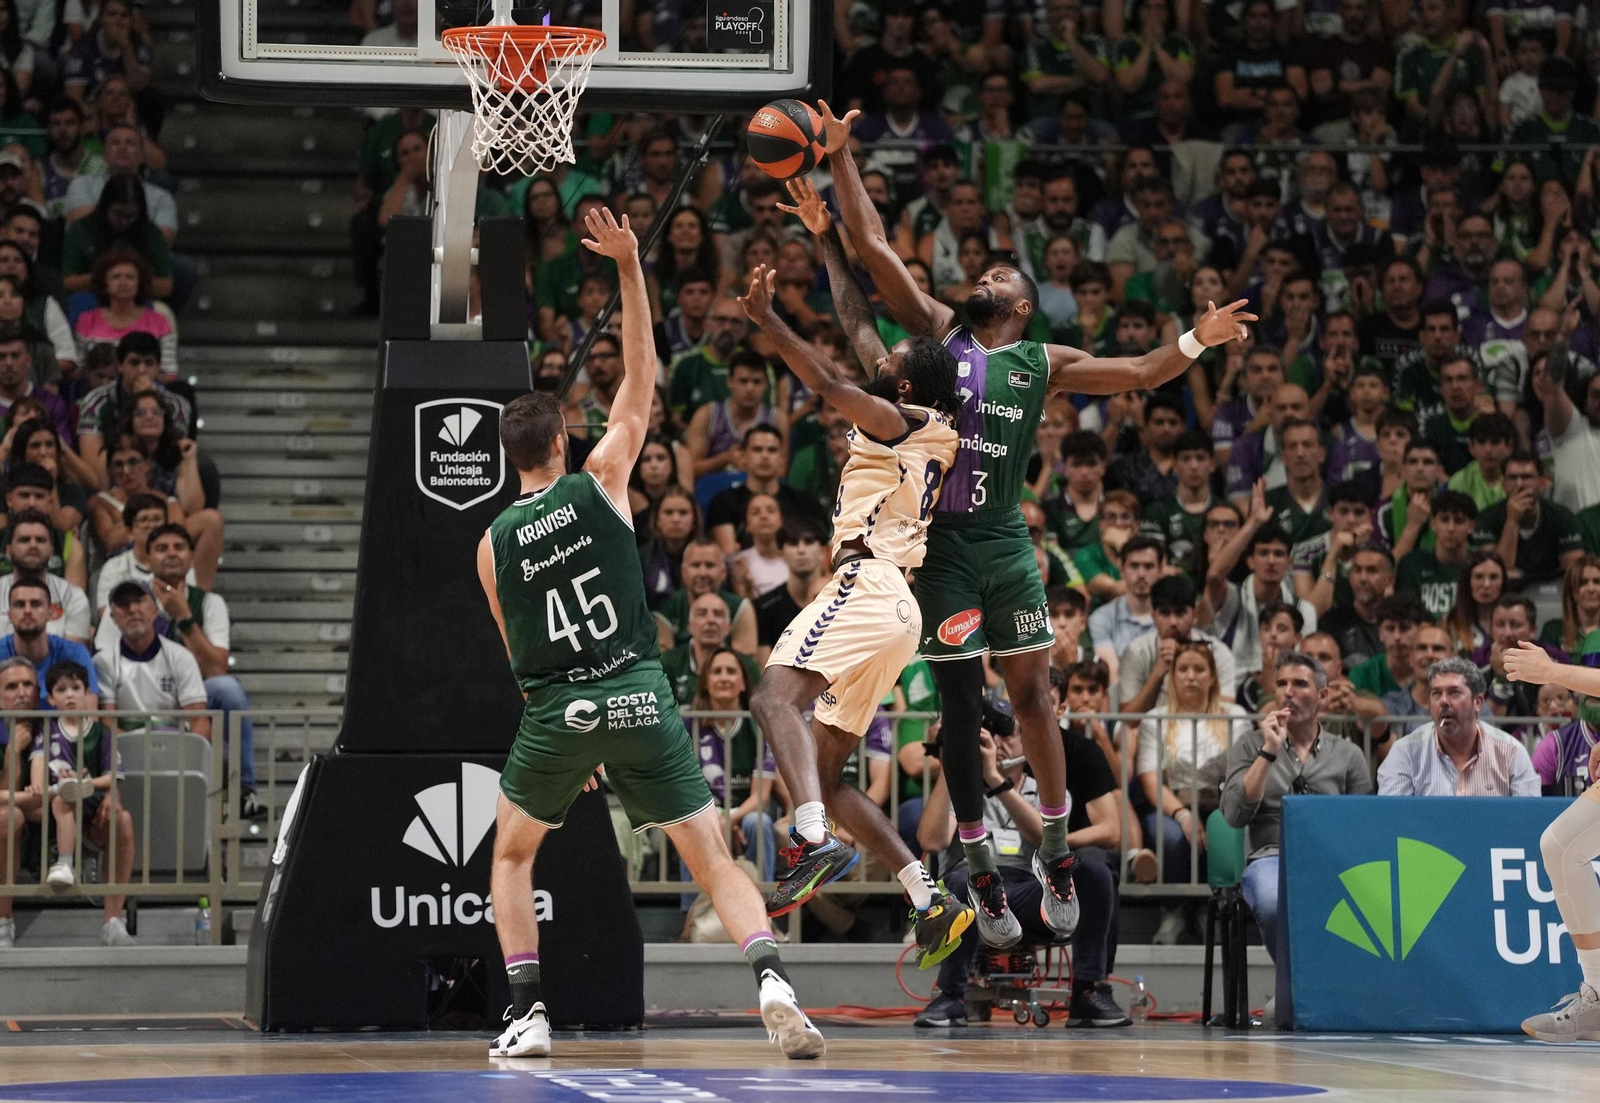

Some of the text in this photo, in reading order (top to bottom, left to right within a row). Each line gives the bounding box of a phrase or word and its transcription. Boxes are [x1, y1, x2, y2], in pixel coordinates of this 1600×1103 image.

[715, 21, 757, 31] PLAYOFF
[430, 450, 491, 462] Fundación
[439, 464, 482, 478] Unicaja
[430, 476, 491, 486] Baloncesto
[971, 470, 989, 506] 3
[919, 459, 943, 521] 8
[516, 503, 578, 547] KRAVISH
[546, 567, 618, 653] 45
[1019, 606, 1044, 624] má
[943, 612, 981, 641] famadesa
[1015, 620, 1046, 634] laga
[606, 692, 658, 708] COSTA
[607, 704, 659, 720] DEL SOL
[608, 715, 661, 730] MÁLAGA
[371, 882, 553, 928] Unica
